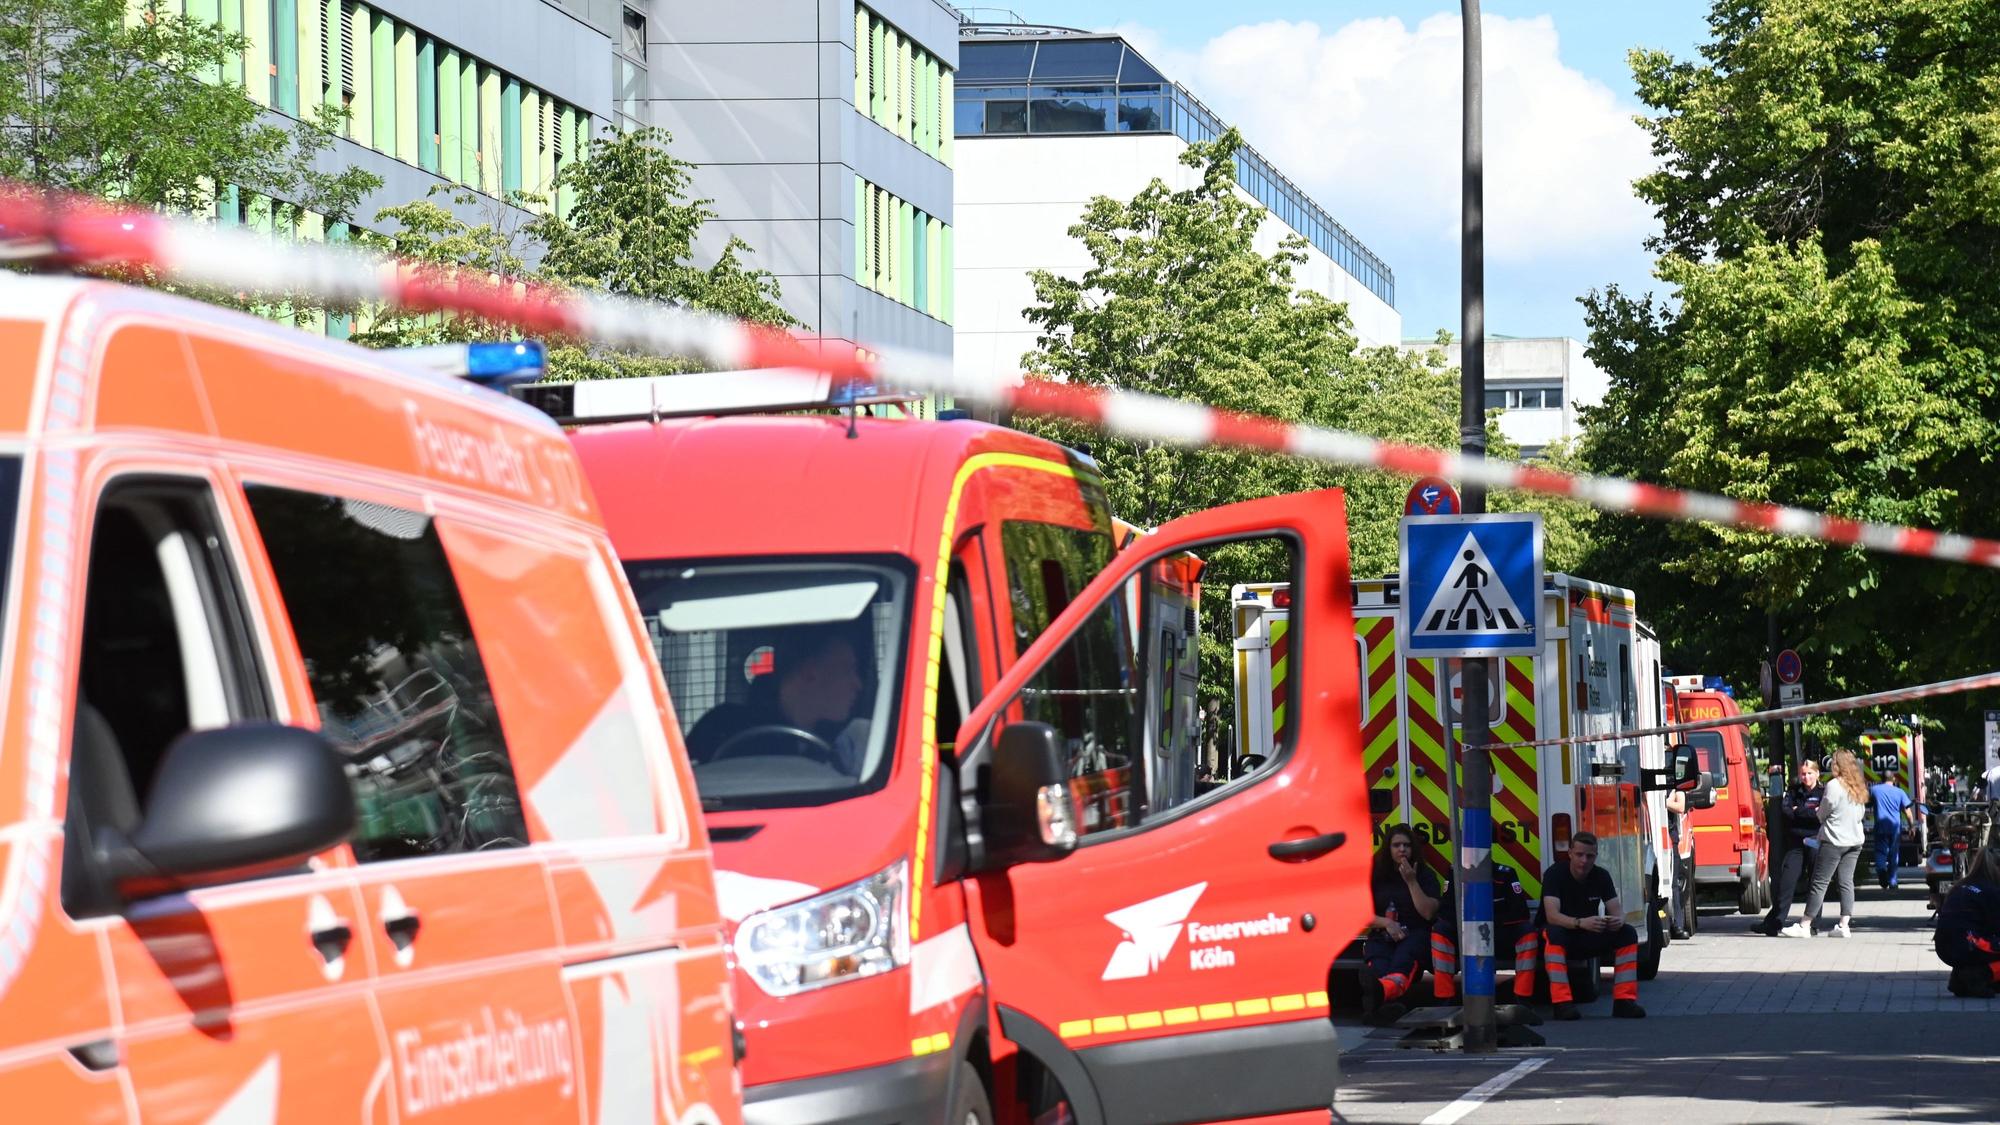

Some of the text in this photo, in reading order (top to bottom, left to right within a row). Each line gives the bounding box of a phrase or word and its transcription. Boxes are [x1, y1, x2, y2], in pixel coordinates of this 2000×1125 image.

[402, 397, 533, 496] Feuerwehr
[1680, 705, 1721, 721] TUNG
[1874, 754, 1898, 769] 112
[1187, 911, 1291, 944] Feuerwehr
[1189, 945, 1236, 971] Köln
[395, 1005, 574, 1117] Einsatzleitung
